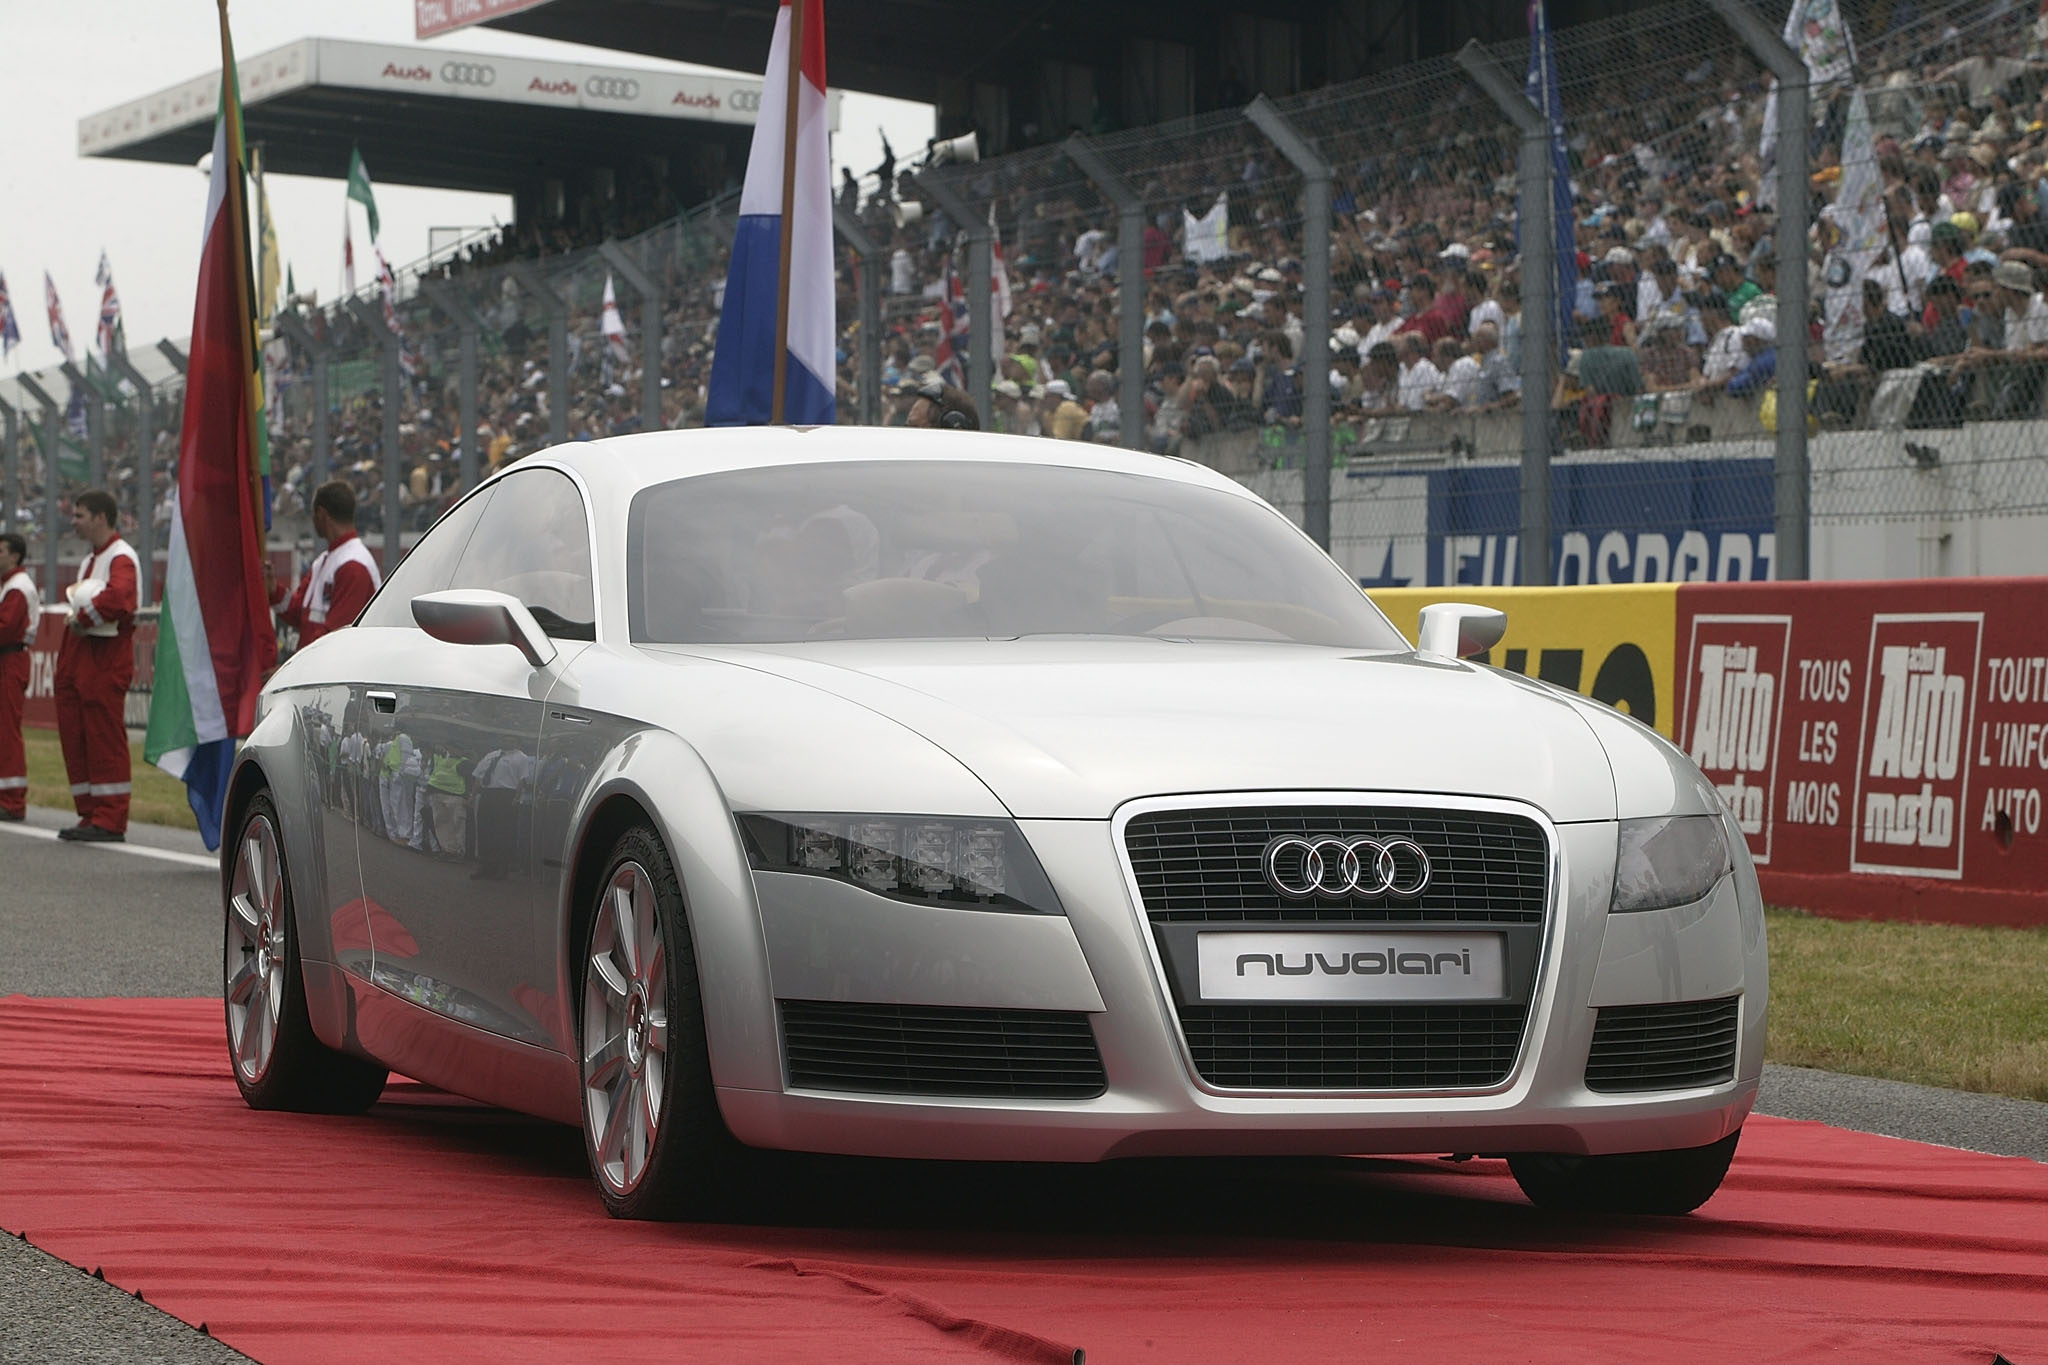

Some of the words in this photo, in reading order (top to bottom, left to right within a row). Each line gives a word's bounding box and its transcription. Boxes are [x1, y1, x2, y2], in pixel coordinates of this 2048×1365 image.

[382, 62, 432, 82] Audi
[528, 77, 577, 96] Audi
[671, 91, 721, 109] Audi
[1799, 659, 1851, 703] TOUS
[1691, 644, 1774, 772] Auto
[1869, 645, 1965, 780] Auto
[1799, 720, 1838, 765] LES
[1787, 781, 1840, 826] MOIS
[1864, 783, 1954, 848] moto
[1236, 948, 1471, 976] nuvolari
